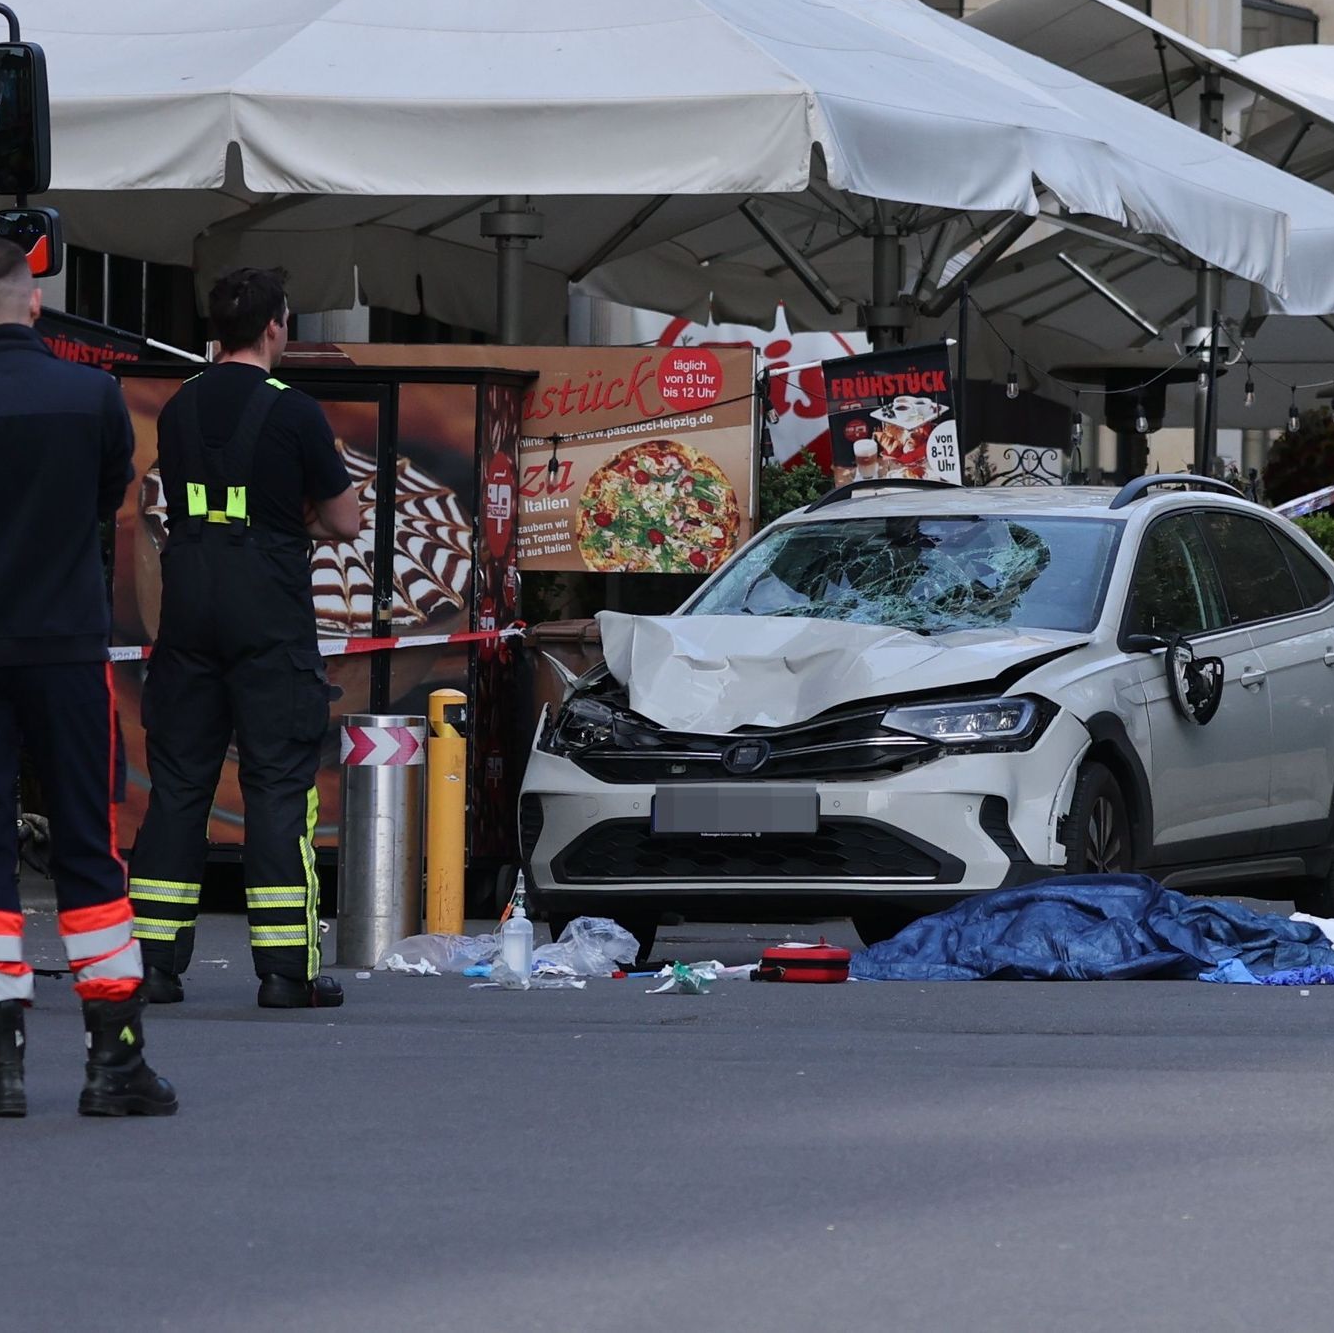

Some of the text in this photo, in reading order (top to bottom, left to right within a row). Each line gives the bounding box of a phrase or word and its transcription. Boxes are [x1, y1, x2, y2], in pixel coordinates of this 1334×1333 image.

[673, 359, 707, 372] täglich
[664, 373, 716, 385] von 8 Uhr
[831, 367, 947, 400] FRÜHSTÜCK
[663, 386, 717, 399] bis 12 Uhr
[520, 435, 545, 448] nline
[576, 413, 714, 440] www.pascucci-leipzig.de
[934, 434, 953, 444] von
[931, 445, 954, 458] 8-12
[937, 459, 956, 473] Uhr
[524, 497, 570, 514] Italien
[554, 518, 569, 529] wir
[532, 532, 571, 544] Tomaten
[526, 547, 543, 557] aus
[544, 543, 572, 554] Italien
